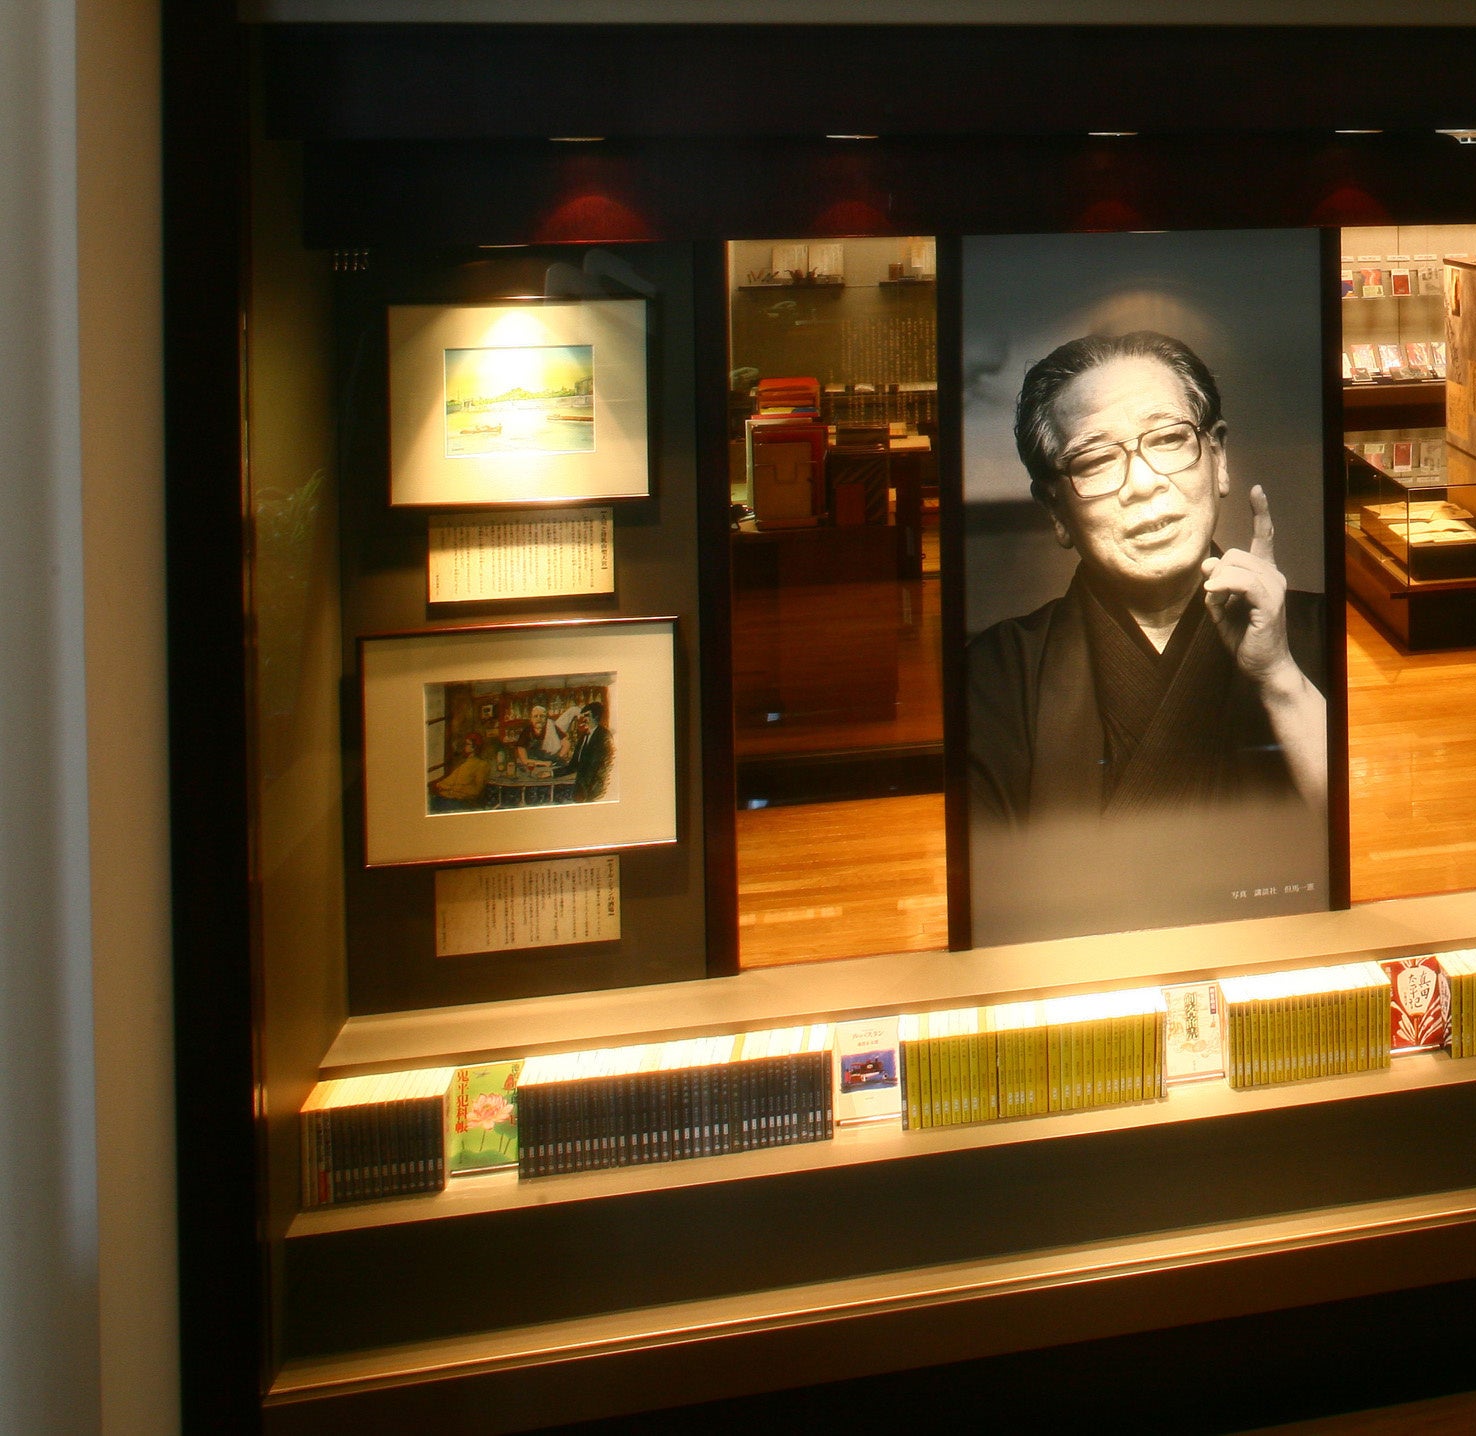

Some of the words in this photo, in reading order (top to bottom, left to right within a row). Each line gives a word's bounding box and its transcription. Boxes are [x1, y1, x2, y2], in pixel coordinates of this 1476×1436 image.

[455, 1069, 469, 1134] 鬼平犯科帳
